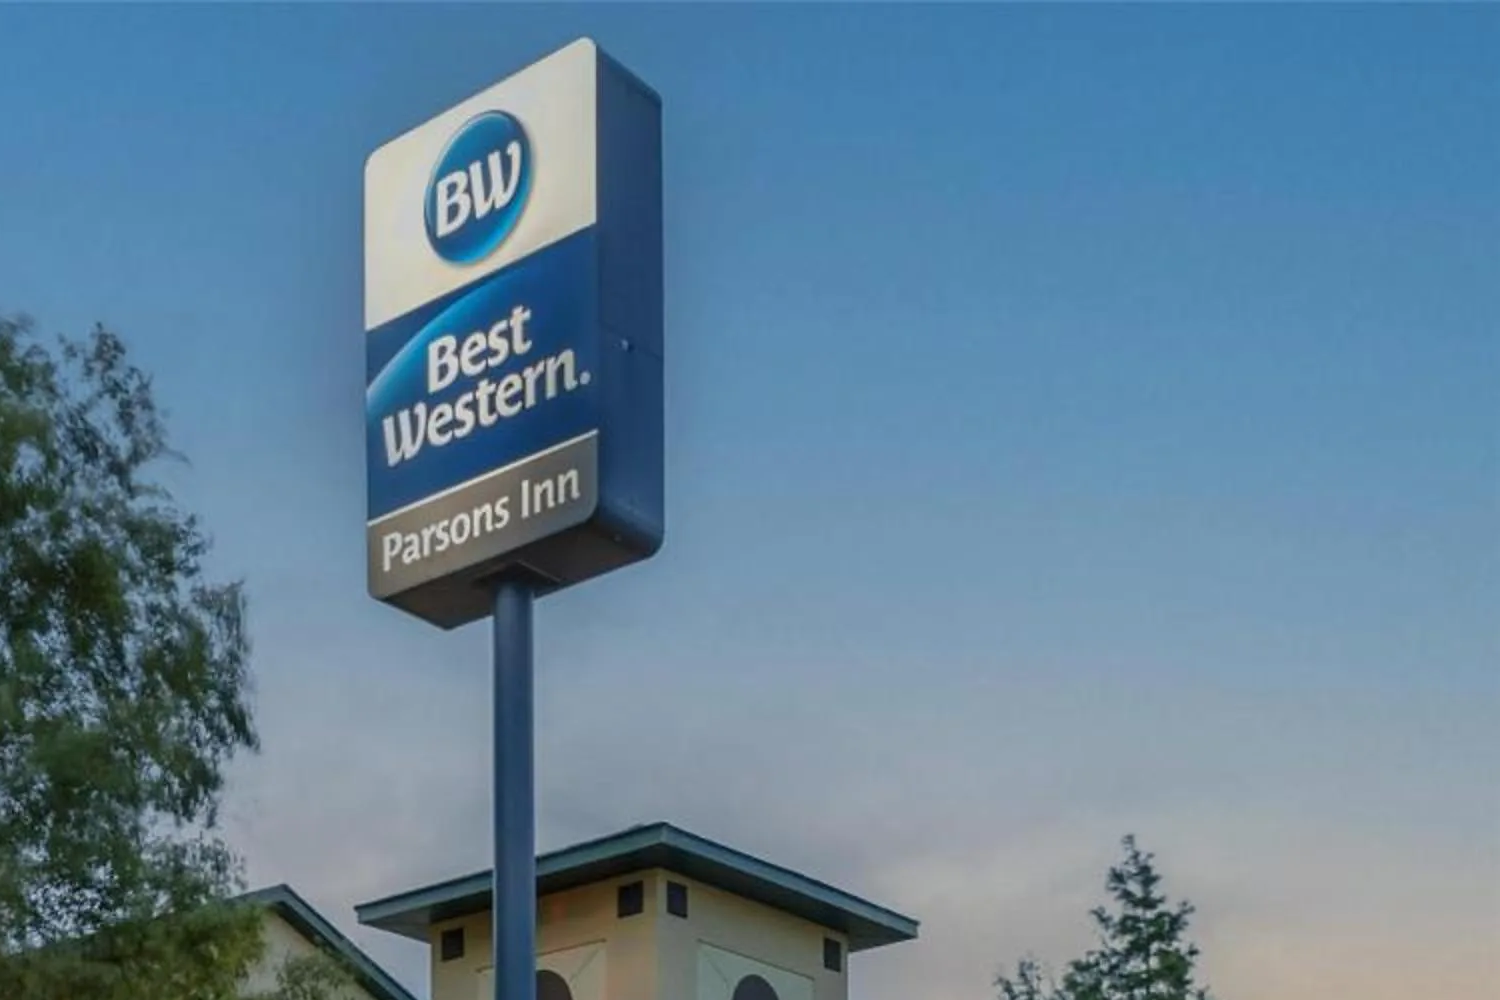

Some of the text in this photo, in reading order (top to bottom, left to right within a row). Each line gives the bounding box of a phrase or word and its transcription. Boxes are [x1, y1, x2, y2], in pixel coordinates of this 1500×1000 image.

[435, 140, 521, 238] BW
[427, 305, 532, 393] Best
[382, 468, 581, 572] Parsons Inn
